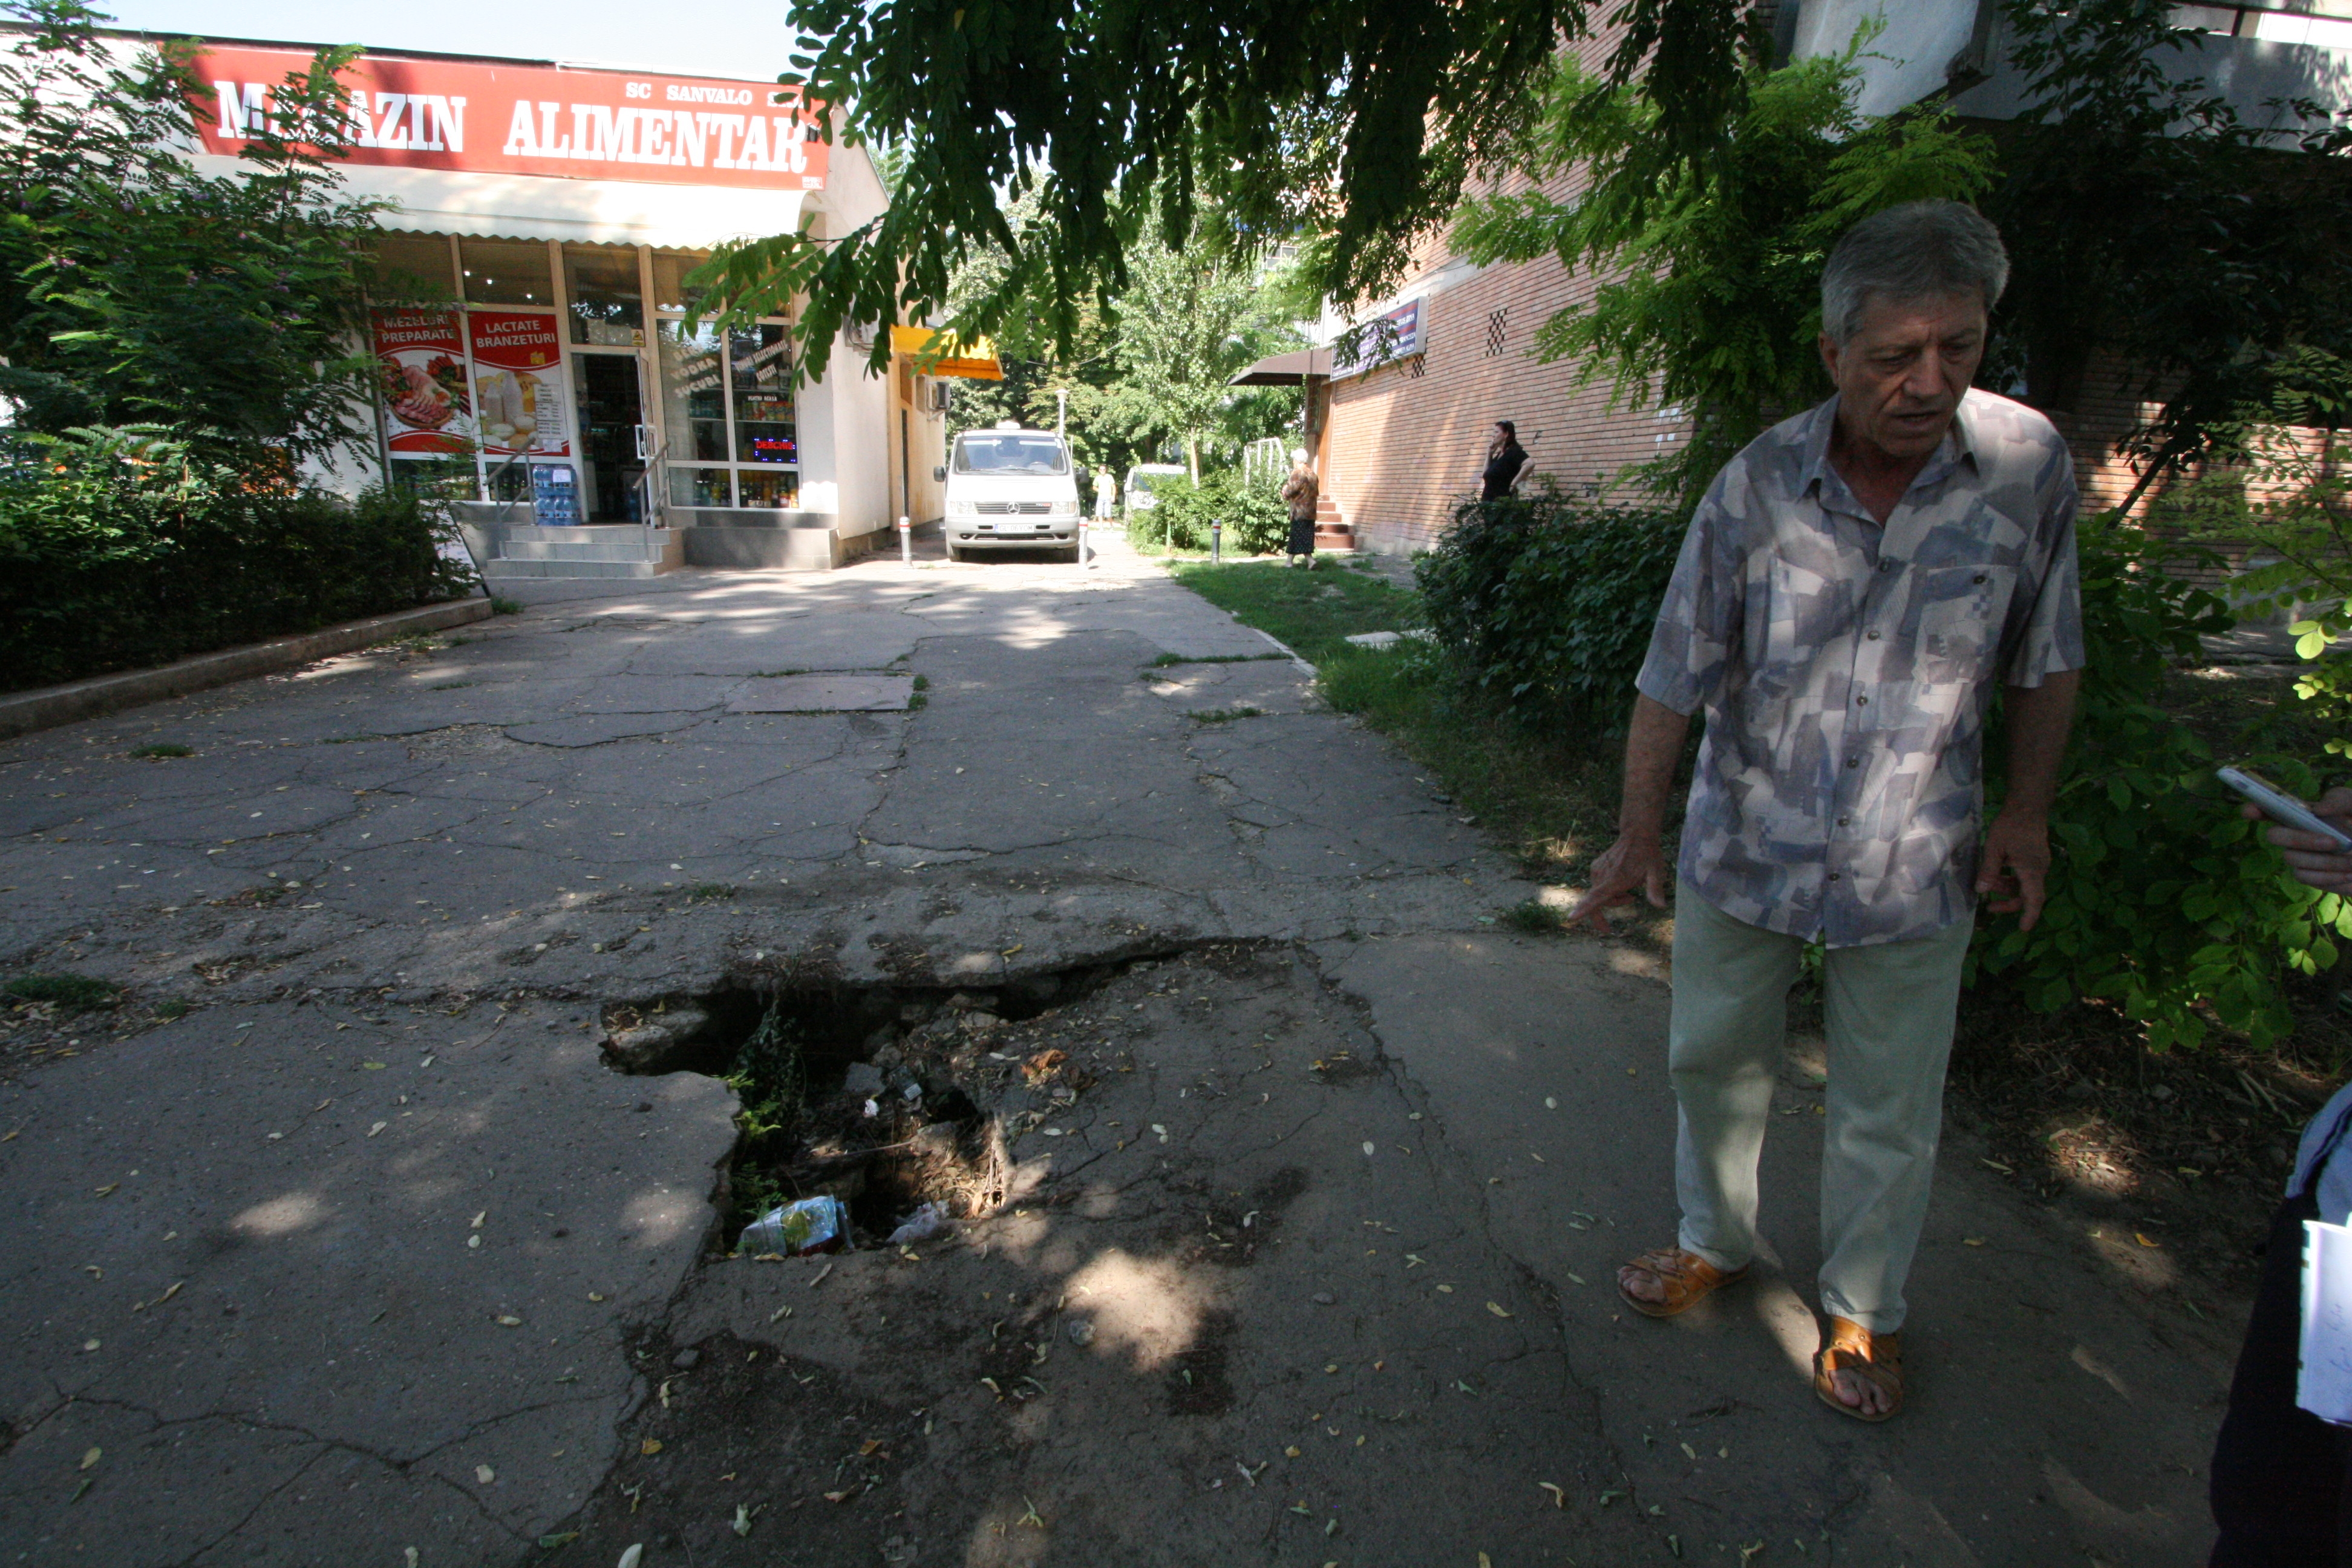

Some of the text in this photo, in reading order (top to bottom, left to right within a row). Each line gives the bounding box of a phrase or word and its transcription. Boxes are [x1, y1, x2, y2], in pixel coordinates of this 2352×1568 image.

[626, 82, 806, 109] SC SANVALO SL
[503, 100, 808, 174] ALIMENTAR
[485, 320, 541, 333] LACTATE
[670, 358, 718, 381] VODKA
[675, 374, 722, 399] SUCURI
[756, 440, 794, 450] DESCHIS
